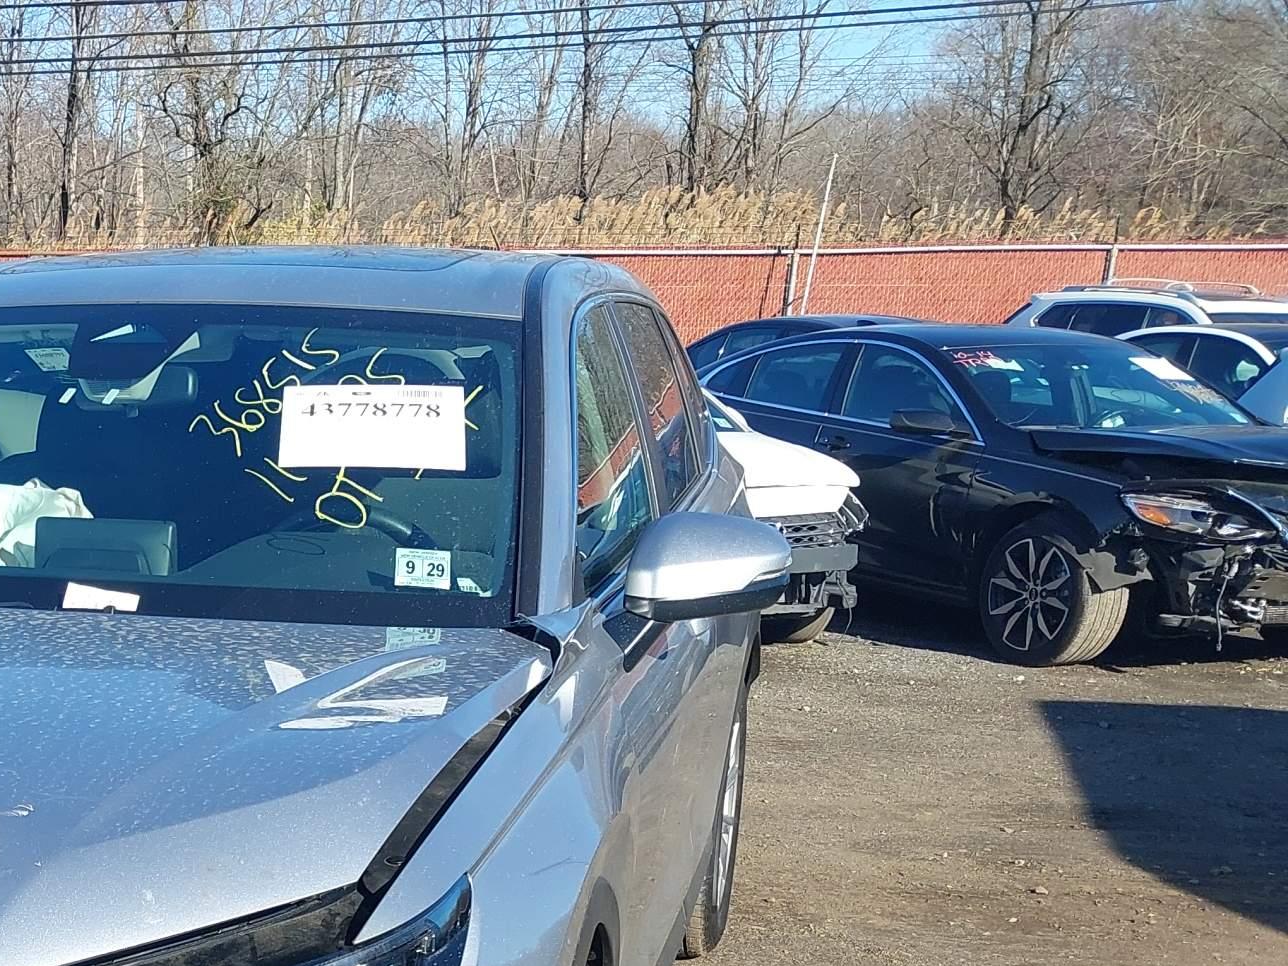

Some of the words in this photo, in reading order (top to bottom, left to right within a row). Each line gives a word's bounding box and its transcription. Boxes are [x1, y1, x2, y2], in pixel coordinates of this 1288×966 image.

[301, 402, 441, 418] 43778778
[406, 561, 415, 574] 9
[427, 563, 445, 578] 29
